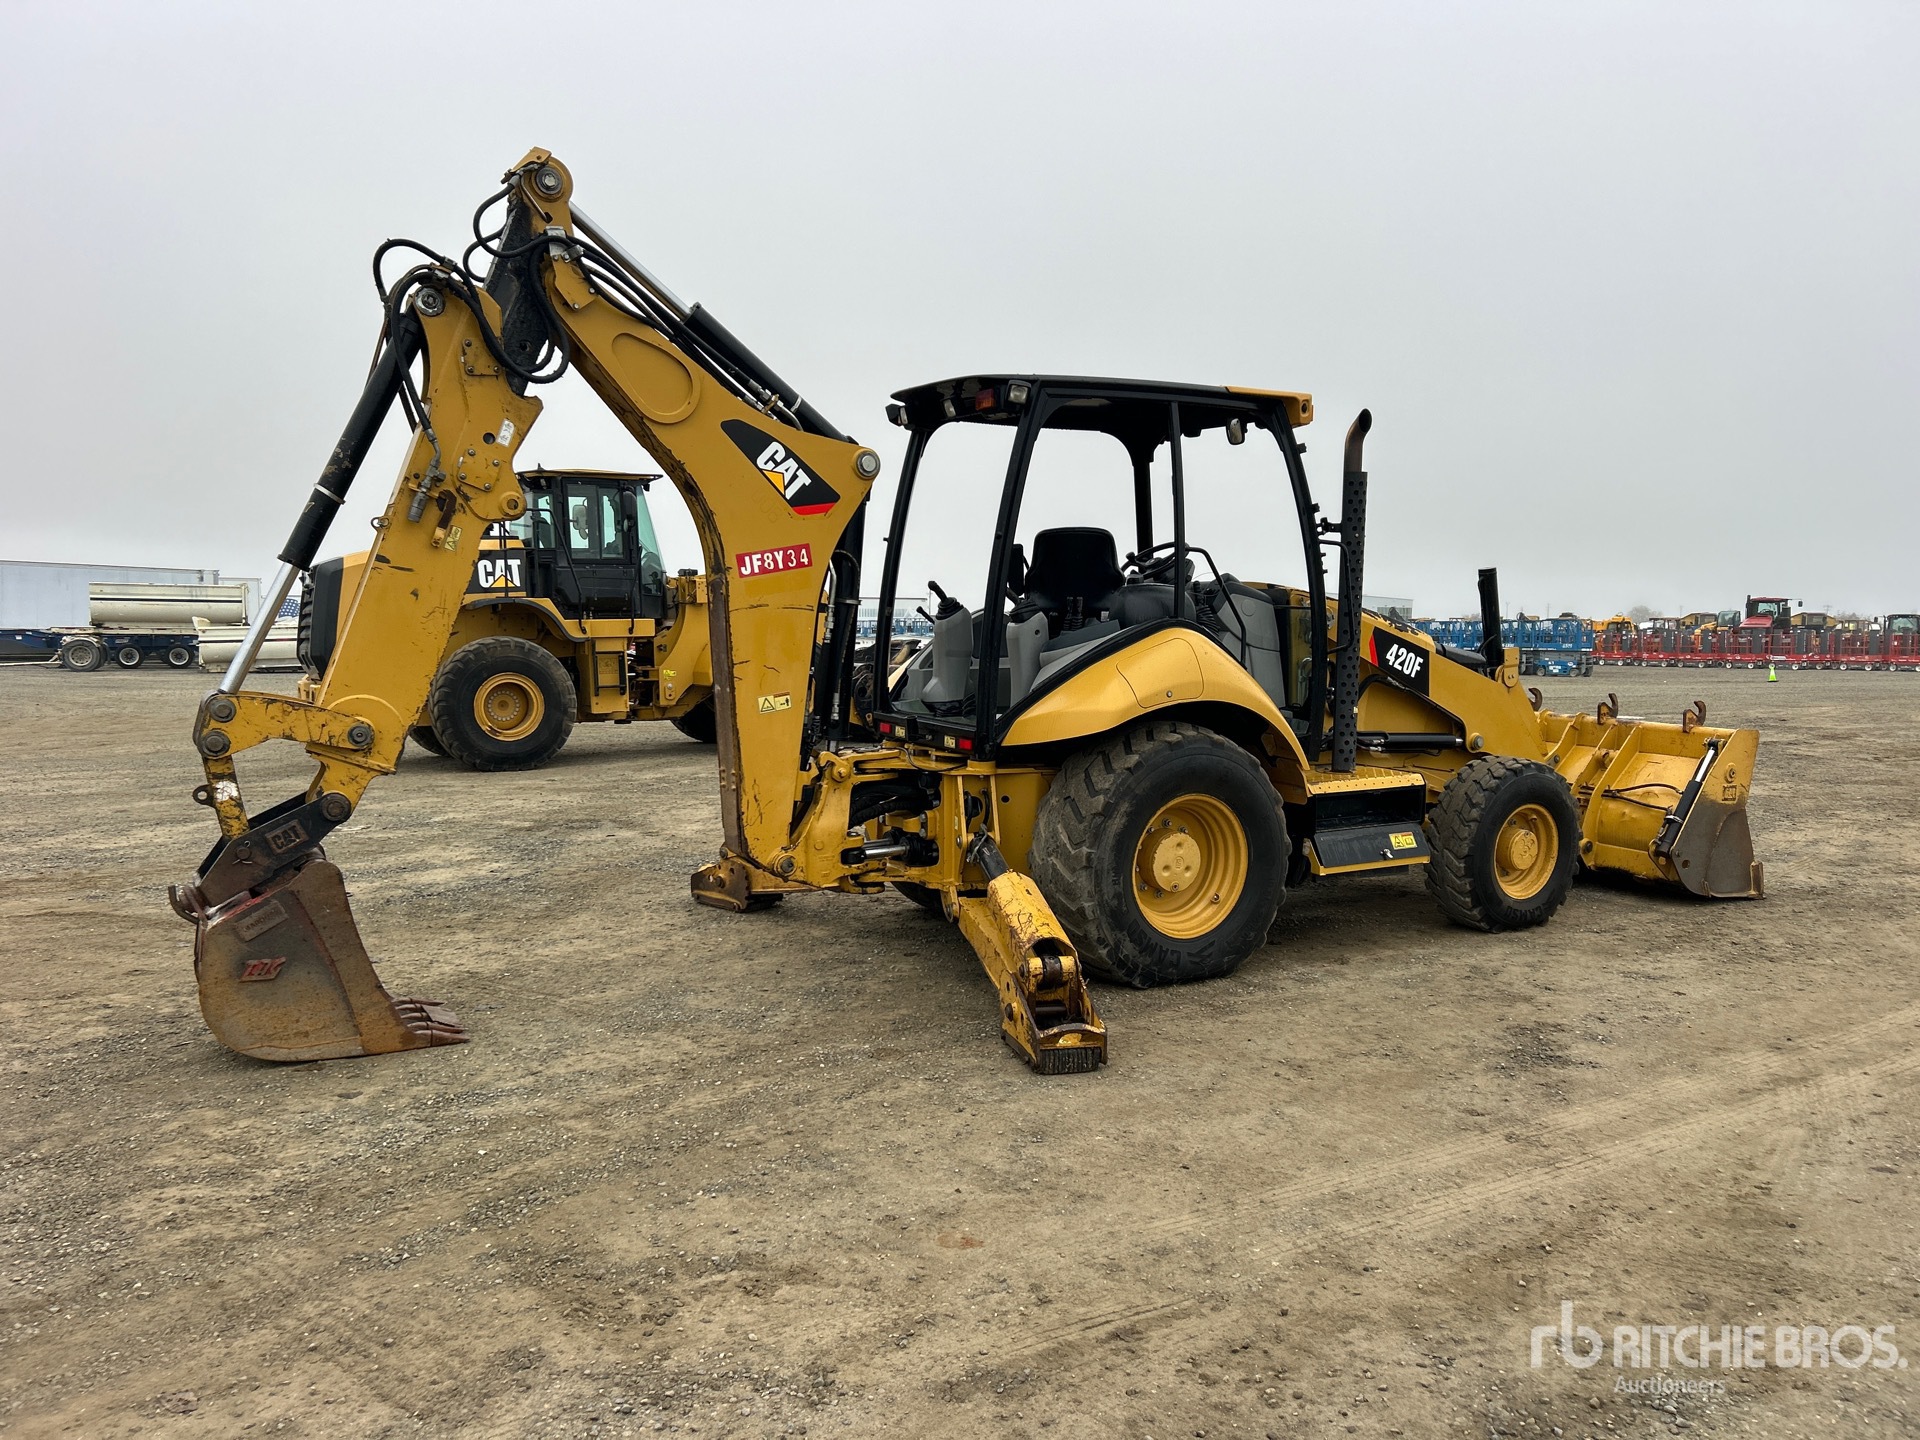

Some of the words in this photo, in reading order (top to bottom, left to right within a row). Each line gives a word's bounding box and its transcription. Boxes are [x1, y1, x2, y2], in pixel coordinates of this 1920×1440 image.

[756, 441, 812, 500] CAT
[477, 559, 521, 588] CAT
[740, 549, 809, 575] JF8Y34
[1386, 643, 1424, 678] 420F
[271, 825, 301, 849] CAT
